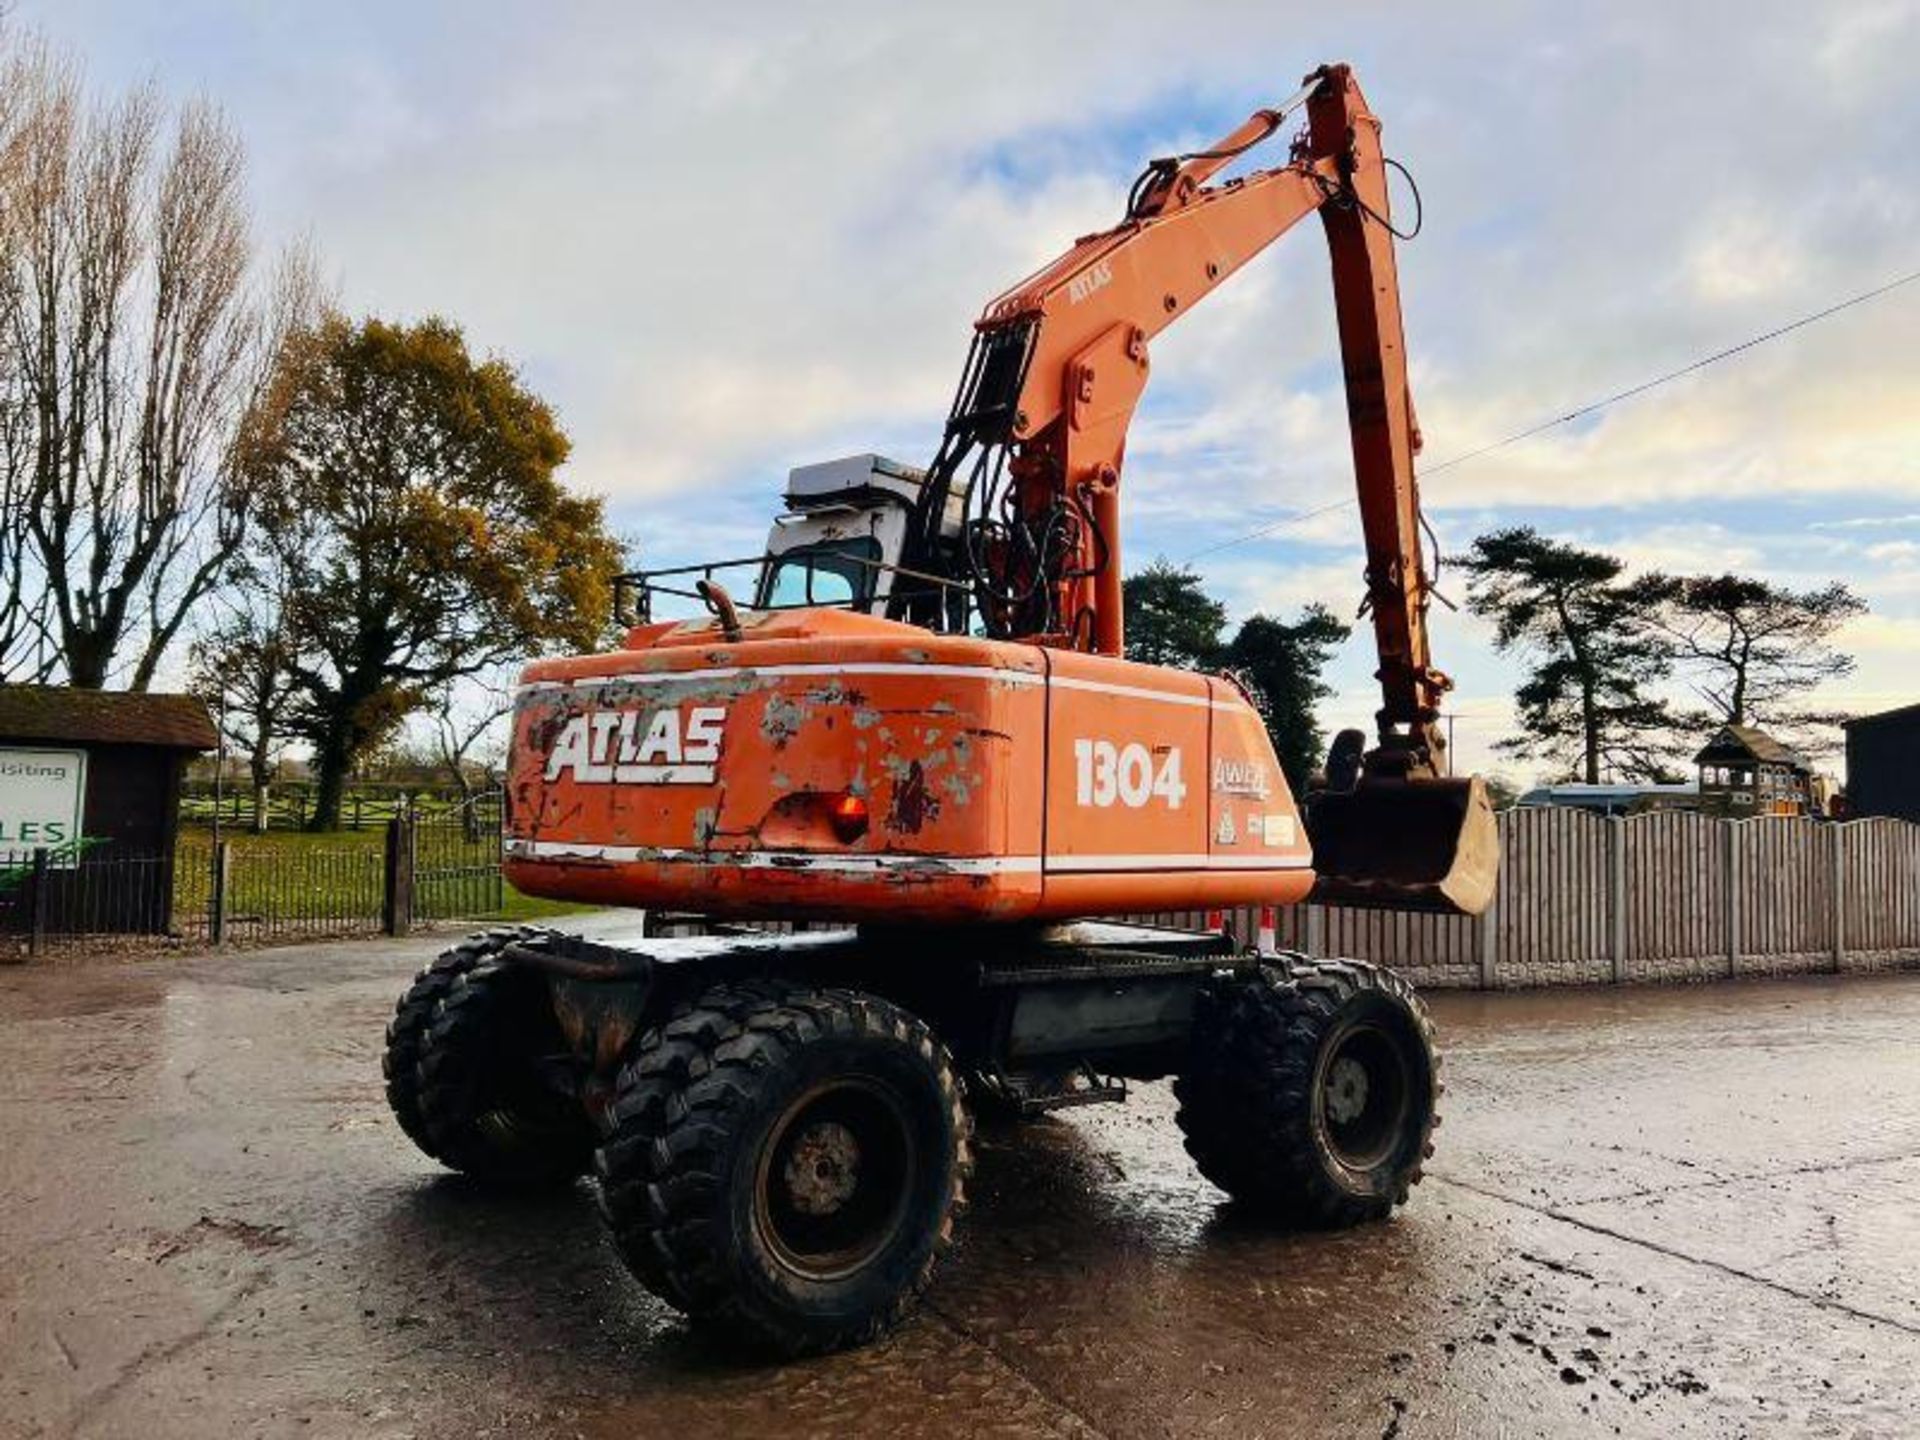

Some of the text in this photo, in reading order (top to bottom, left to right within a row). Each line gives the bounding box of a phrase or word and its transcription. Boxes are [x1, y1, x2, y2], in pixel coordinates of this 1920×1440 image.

[1068, 259, 1113, 305] ATLAS
[543, 706, 726, 783] ATLAS
[1074, 738, 1187, 809] 1304
